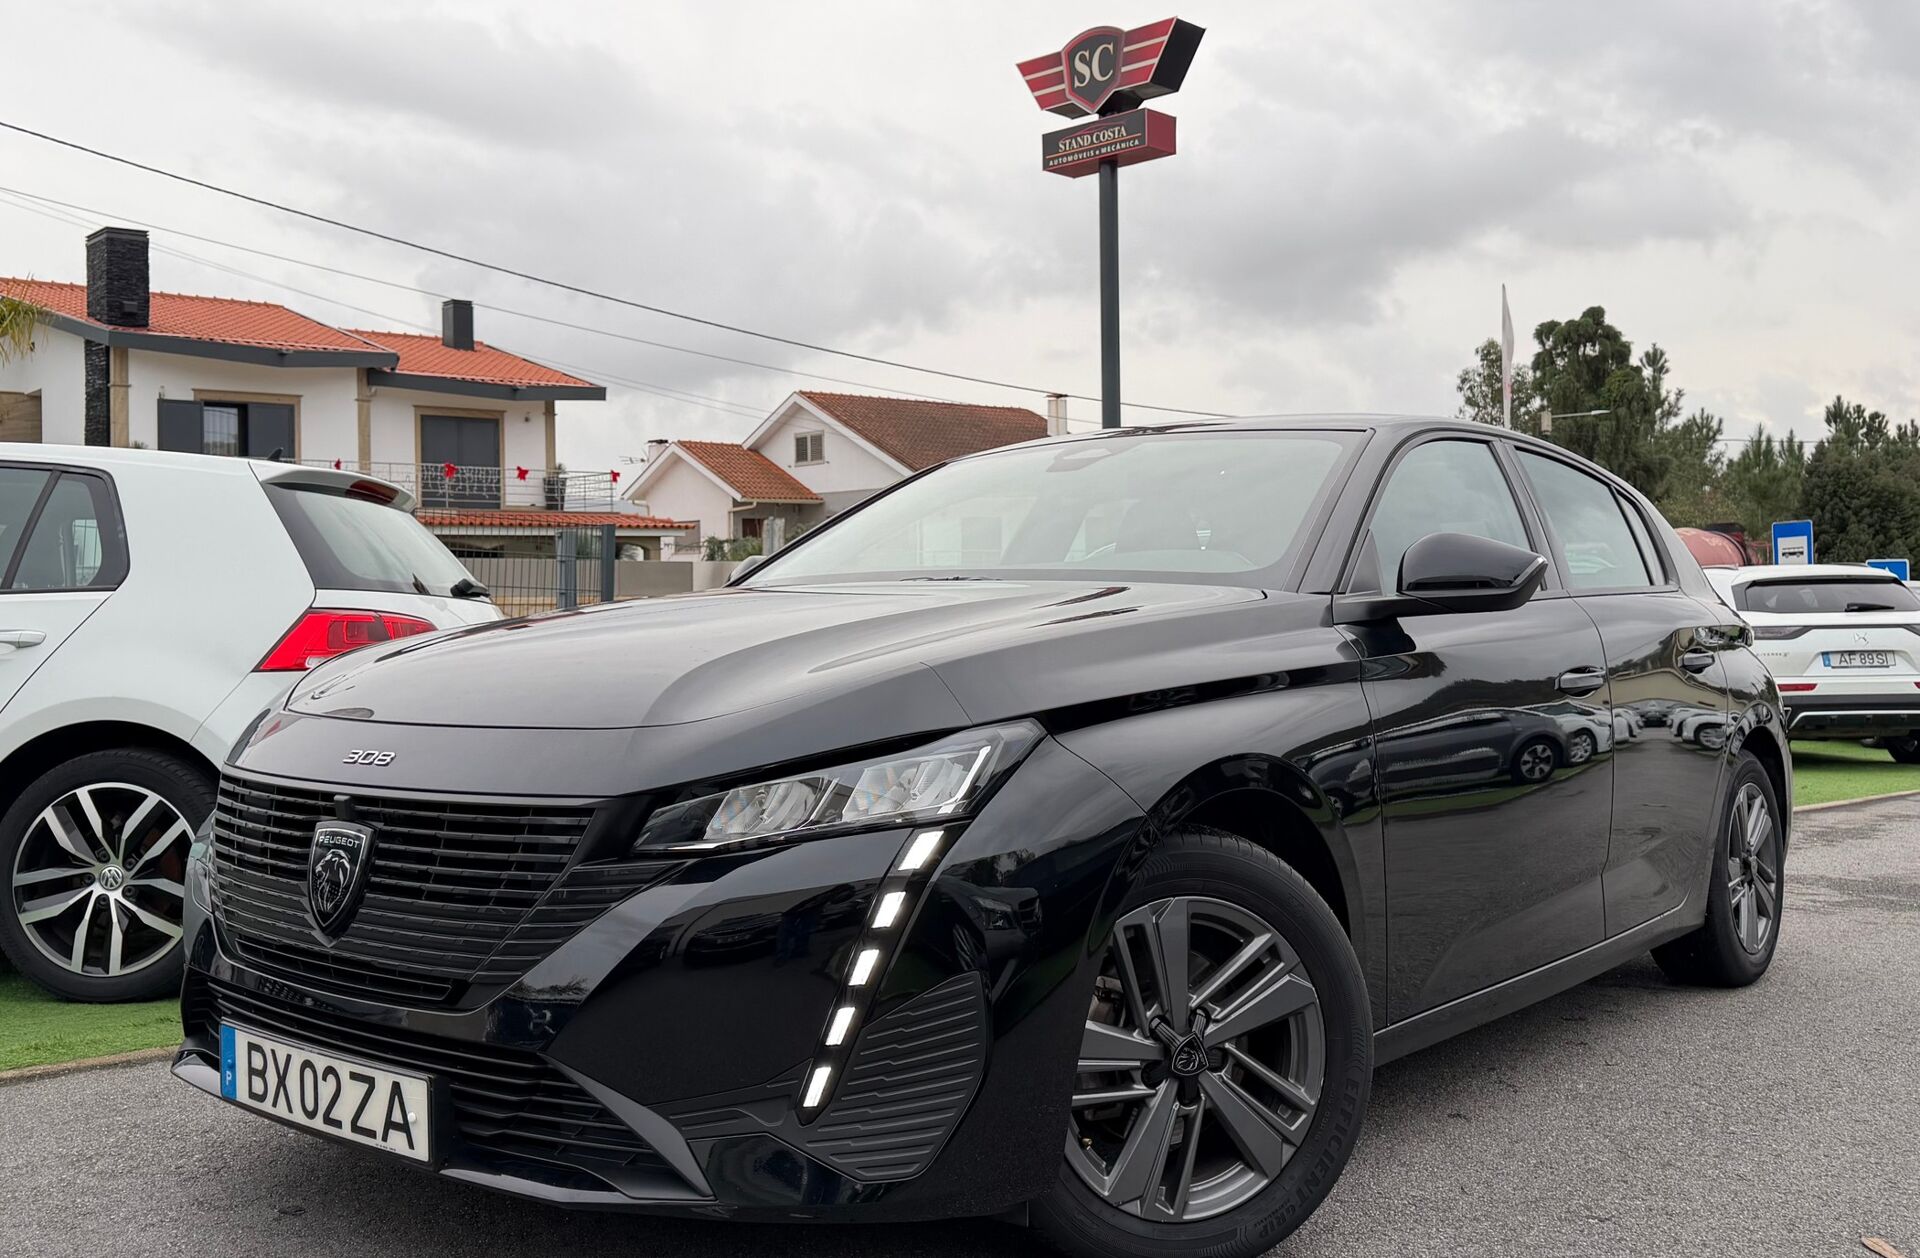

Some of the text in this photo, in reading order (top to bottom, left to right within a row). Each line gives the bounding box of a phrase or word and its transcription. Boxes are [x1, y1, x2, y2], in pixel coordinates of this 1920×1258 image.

[1074, 42, 1114, 88] SC
[1058, 125, 1127, 152] STAND COSTA
[1049, 149, 1094, 166] AUTOMÓVEIS
[1100, 139, 1140, 155] MECÂNICA
[1838, 652, 1857, 665] AF
[1859, 652, 1875, 665] 89
[342, 749, 396, 766] 308
[318, 834, 361, 849] PEUGEOT
[225, 1070, 233, 1086] P
[247, 1041, 415, 1151] BX02ZA
